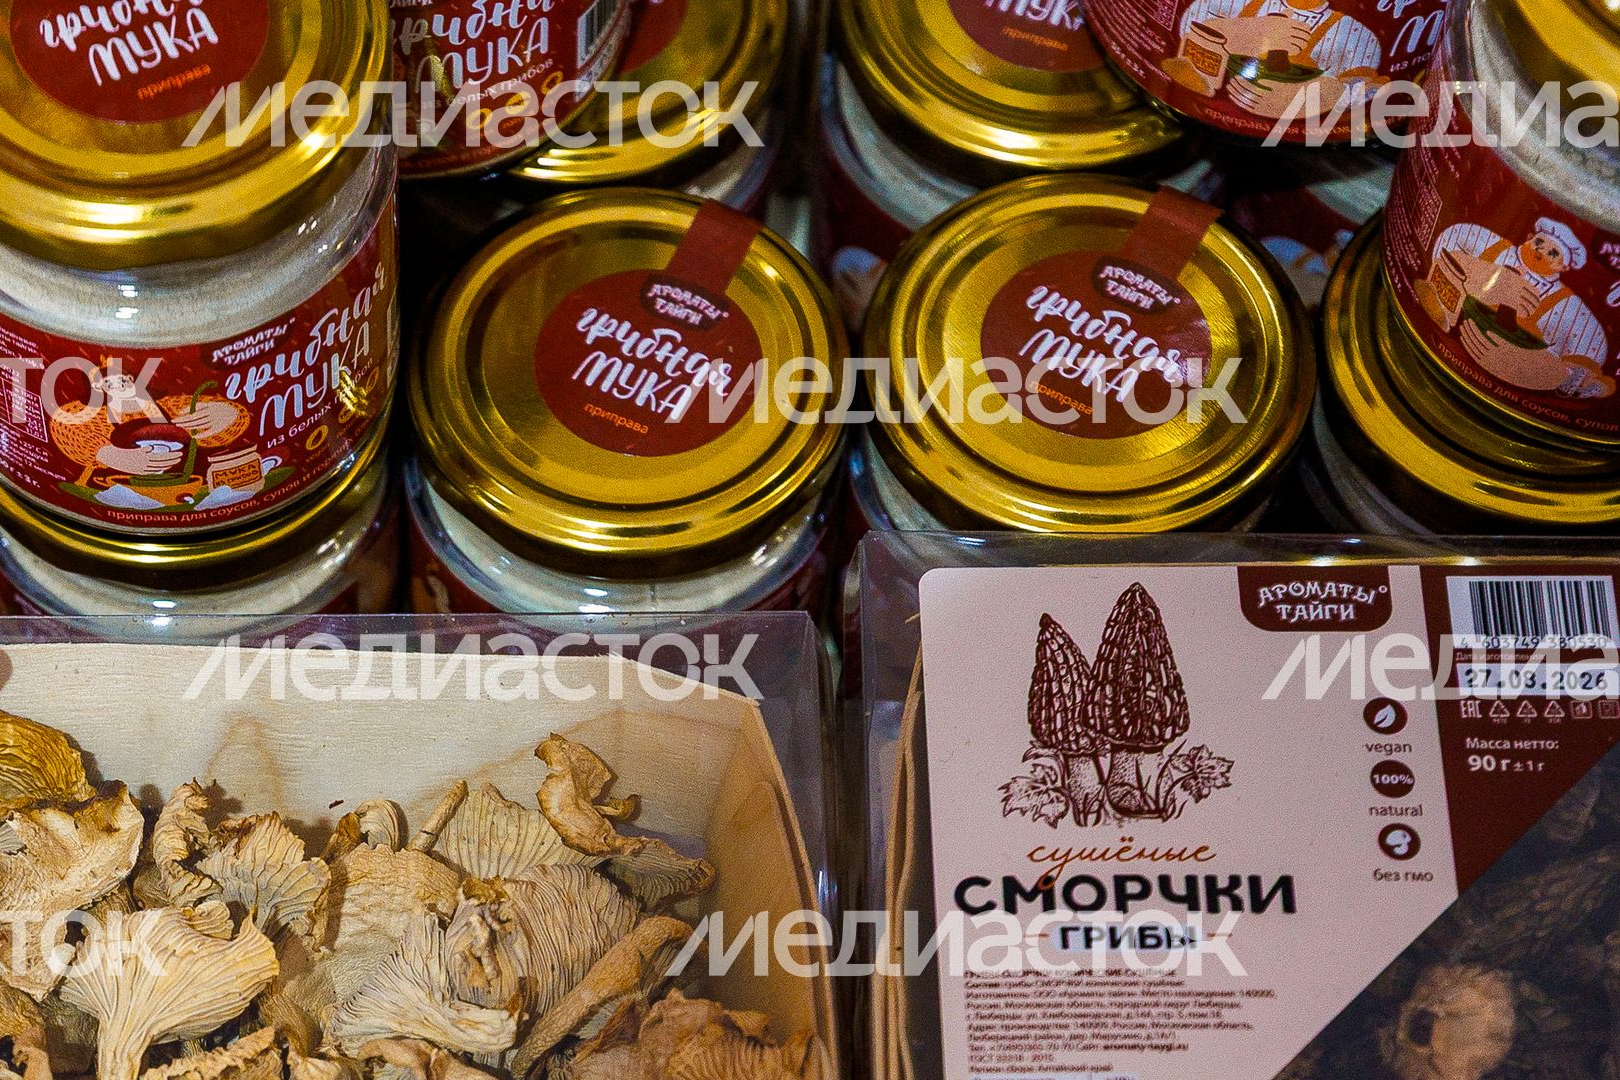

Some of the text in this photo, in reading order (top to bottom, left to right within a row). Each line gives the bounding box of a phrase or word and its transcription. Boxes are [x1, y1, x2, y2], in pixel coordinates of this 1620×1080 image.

[88, 7, 219, 87] МУКА
[137, 63, 212, 100] приправа
[1099, 265, 1173, 306] АРОМАТЫ
[1106, 279, 1154, 310] ТАЙГИ
[211, 324, 288, 363] АРОМАТЫ
[225, 261, 389, 403] грибная
[1026, 285, 1183, 383] грибная
[223, 340, 275, 366] ТАЙГИ
[576, 307, 732, 397] грибная
[1018, 328, 1139, 403] МУКА
[572, 351, 692, 420] МУКА
[1032, 381, 1093, 415] приправа
[1438, 342, 1620, 432] приправа для соусов, супов
[266, 402, 332, 450] из белых
[583, 403, 649, 434] приправа
[107, 482, 300, 523] приправа для соусов, супов
[1259, 581, 1376, 607] АРОМАТЫ
[1276, 600, 1355, 623] ТАЙГИ
[1461, 700, 1482, 718] EAC
[1366, 741, 1412, 757] vegan
[1466, 738, 1559, 749] Масса нетто:
[1373, 774, 1414, 786] 100%
[1468, 755, 1545, 772] 90 г 1 г
[1369, 804, 1424, 818] natural
[1027, 836, 1218, 891] сушёные
[1373, 869, 1434, 882] без гмо
[953, 873, 1298, 915] СМОРЧКИ
[1059, 925, 1198, 950] ГРИБЫ
